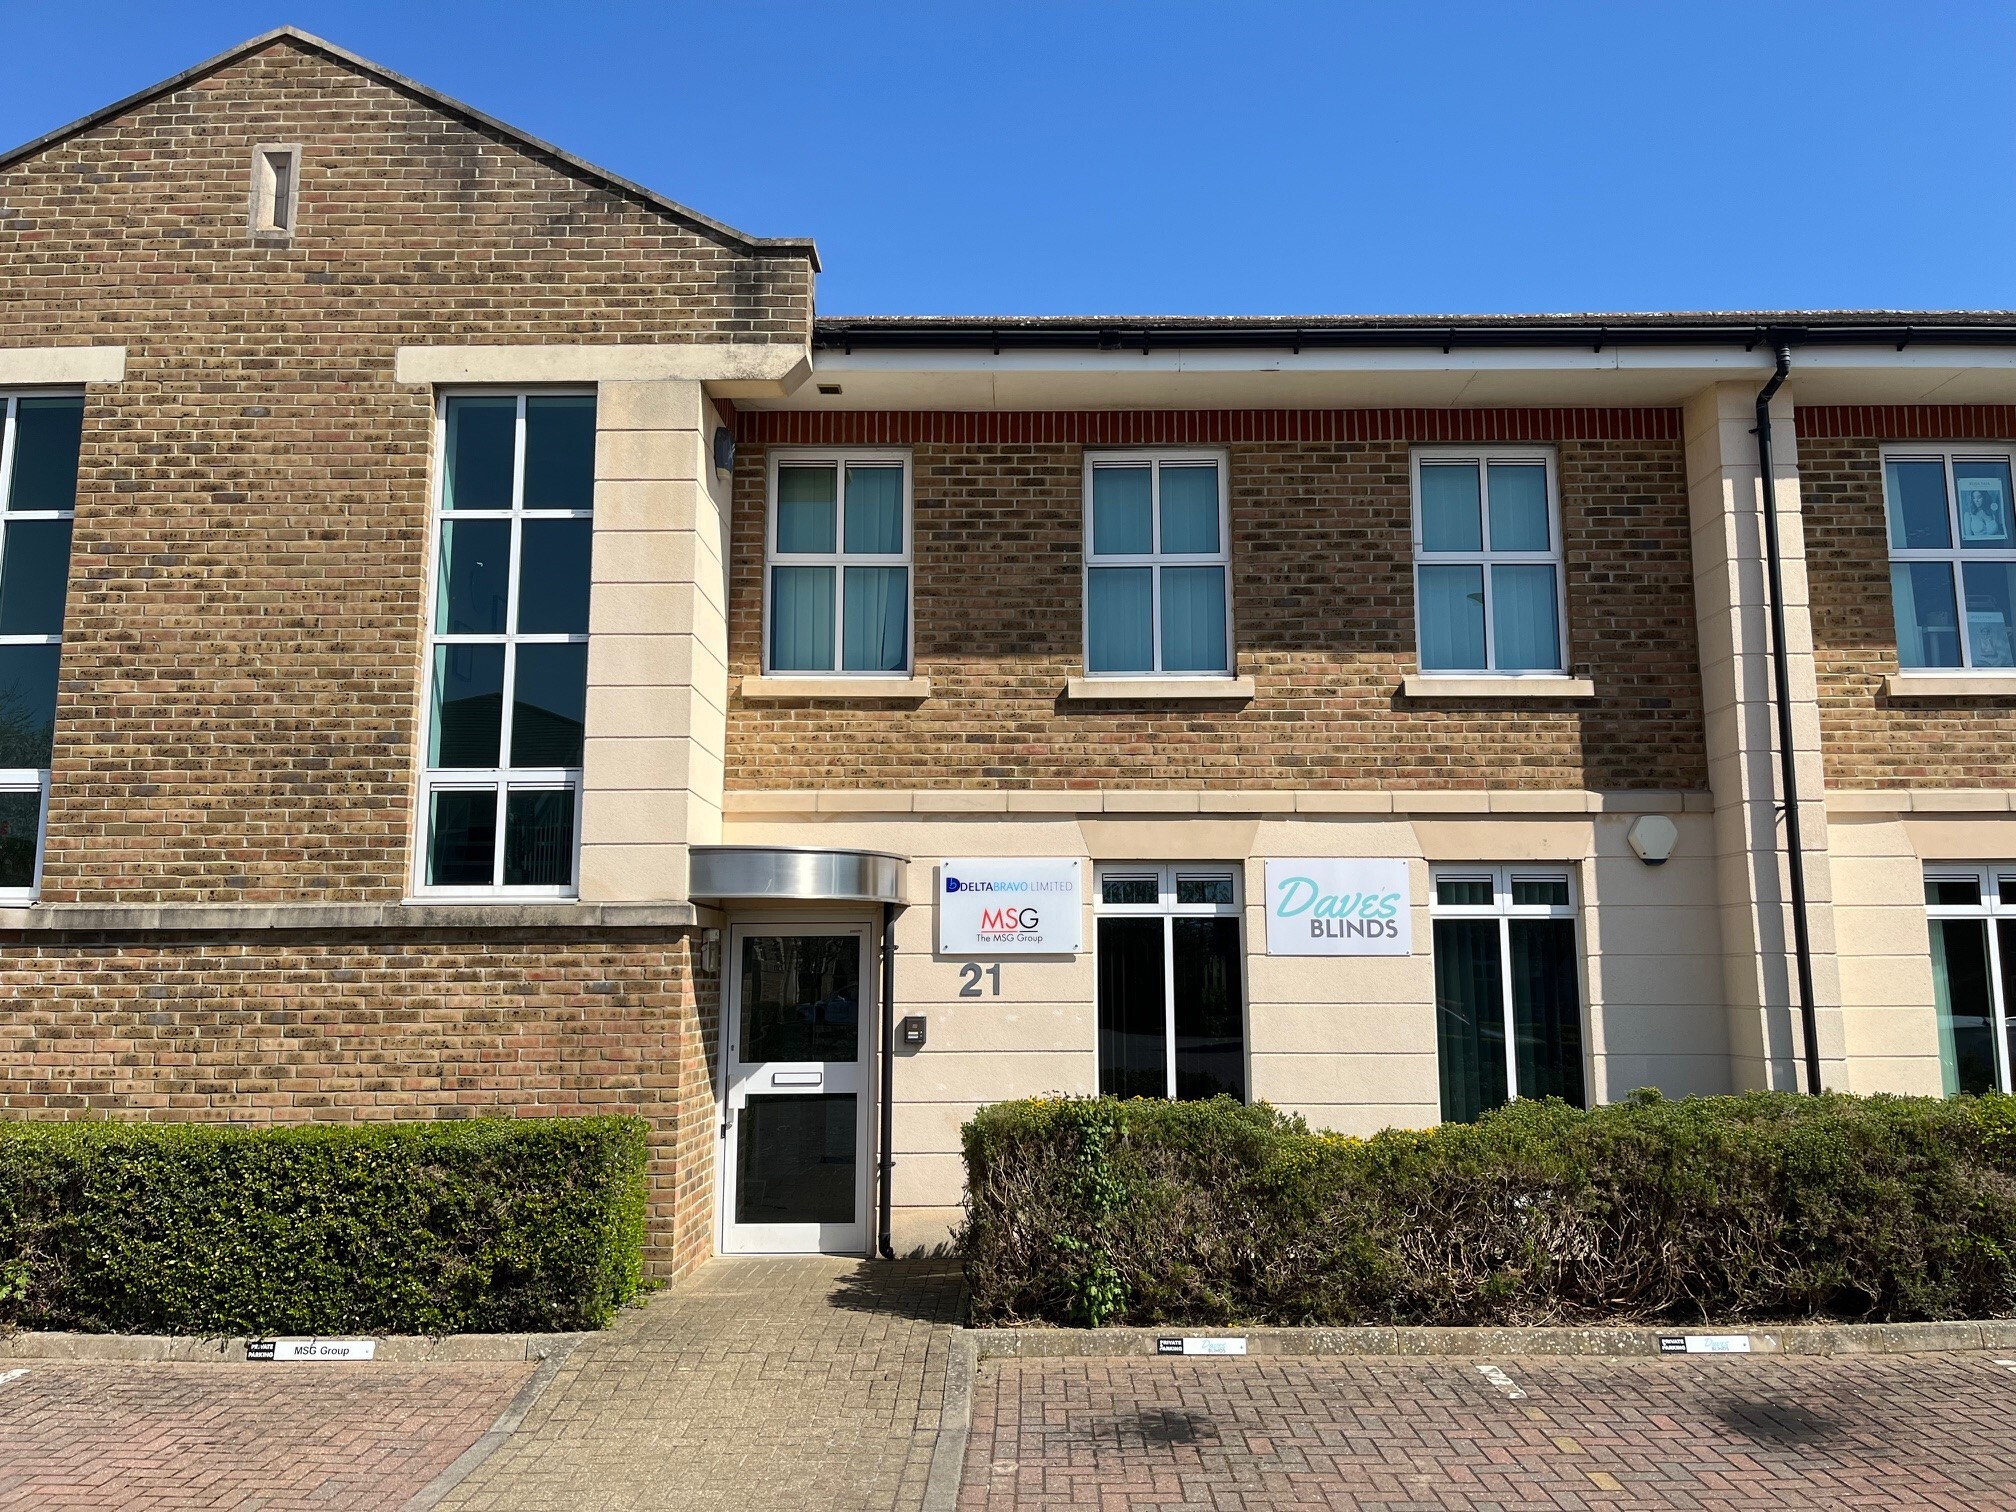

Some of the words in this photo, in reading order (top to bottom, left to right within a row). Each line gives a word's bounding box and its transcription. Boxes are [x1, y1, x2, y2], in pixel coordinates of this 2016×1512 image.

[1030, 881, 1073, 892] LIMITED
[981, 907, 1039, 929] MSG
[1310, 918, 1399, 939] BLINDS
[976, 933, 991, 943] The
[993, 933, 1014, 943] MSG
[1017, 933, 1044, 944] Group
[959, 962, 1001, 998] 21
[294, 1346, 317, 1355] MSG
[320, 1346, 350, 1357] Group
